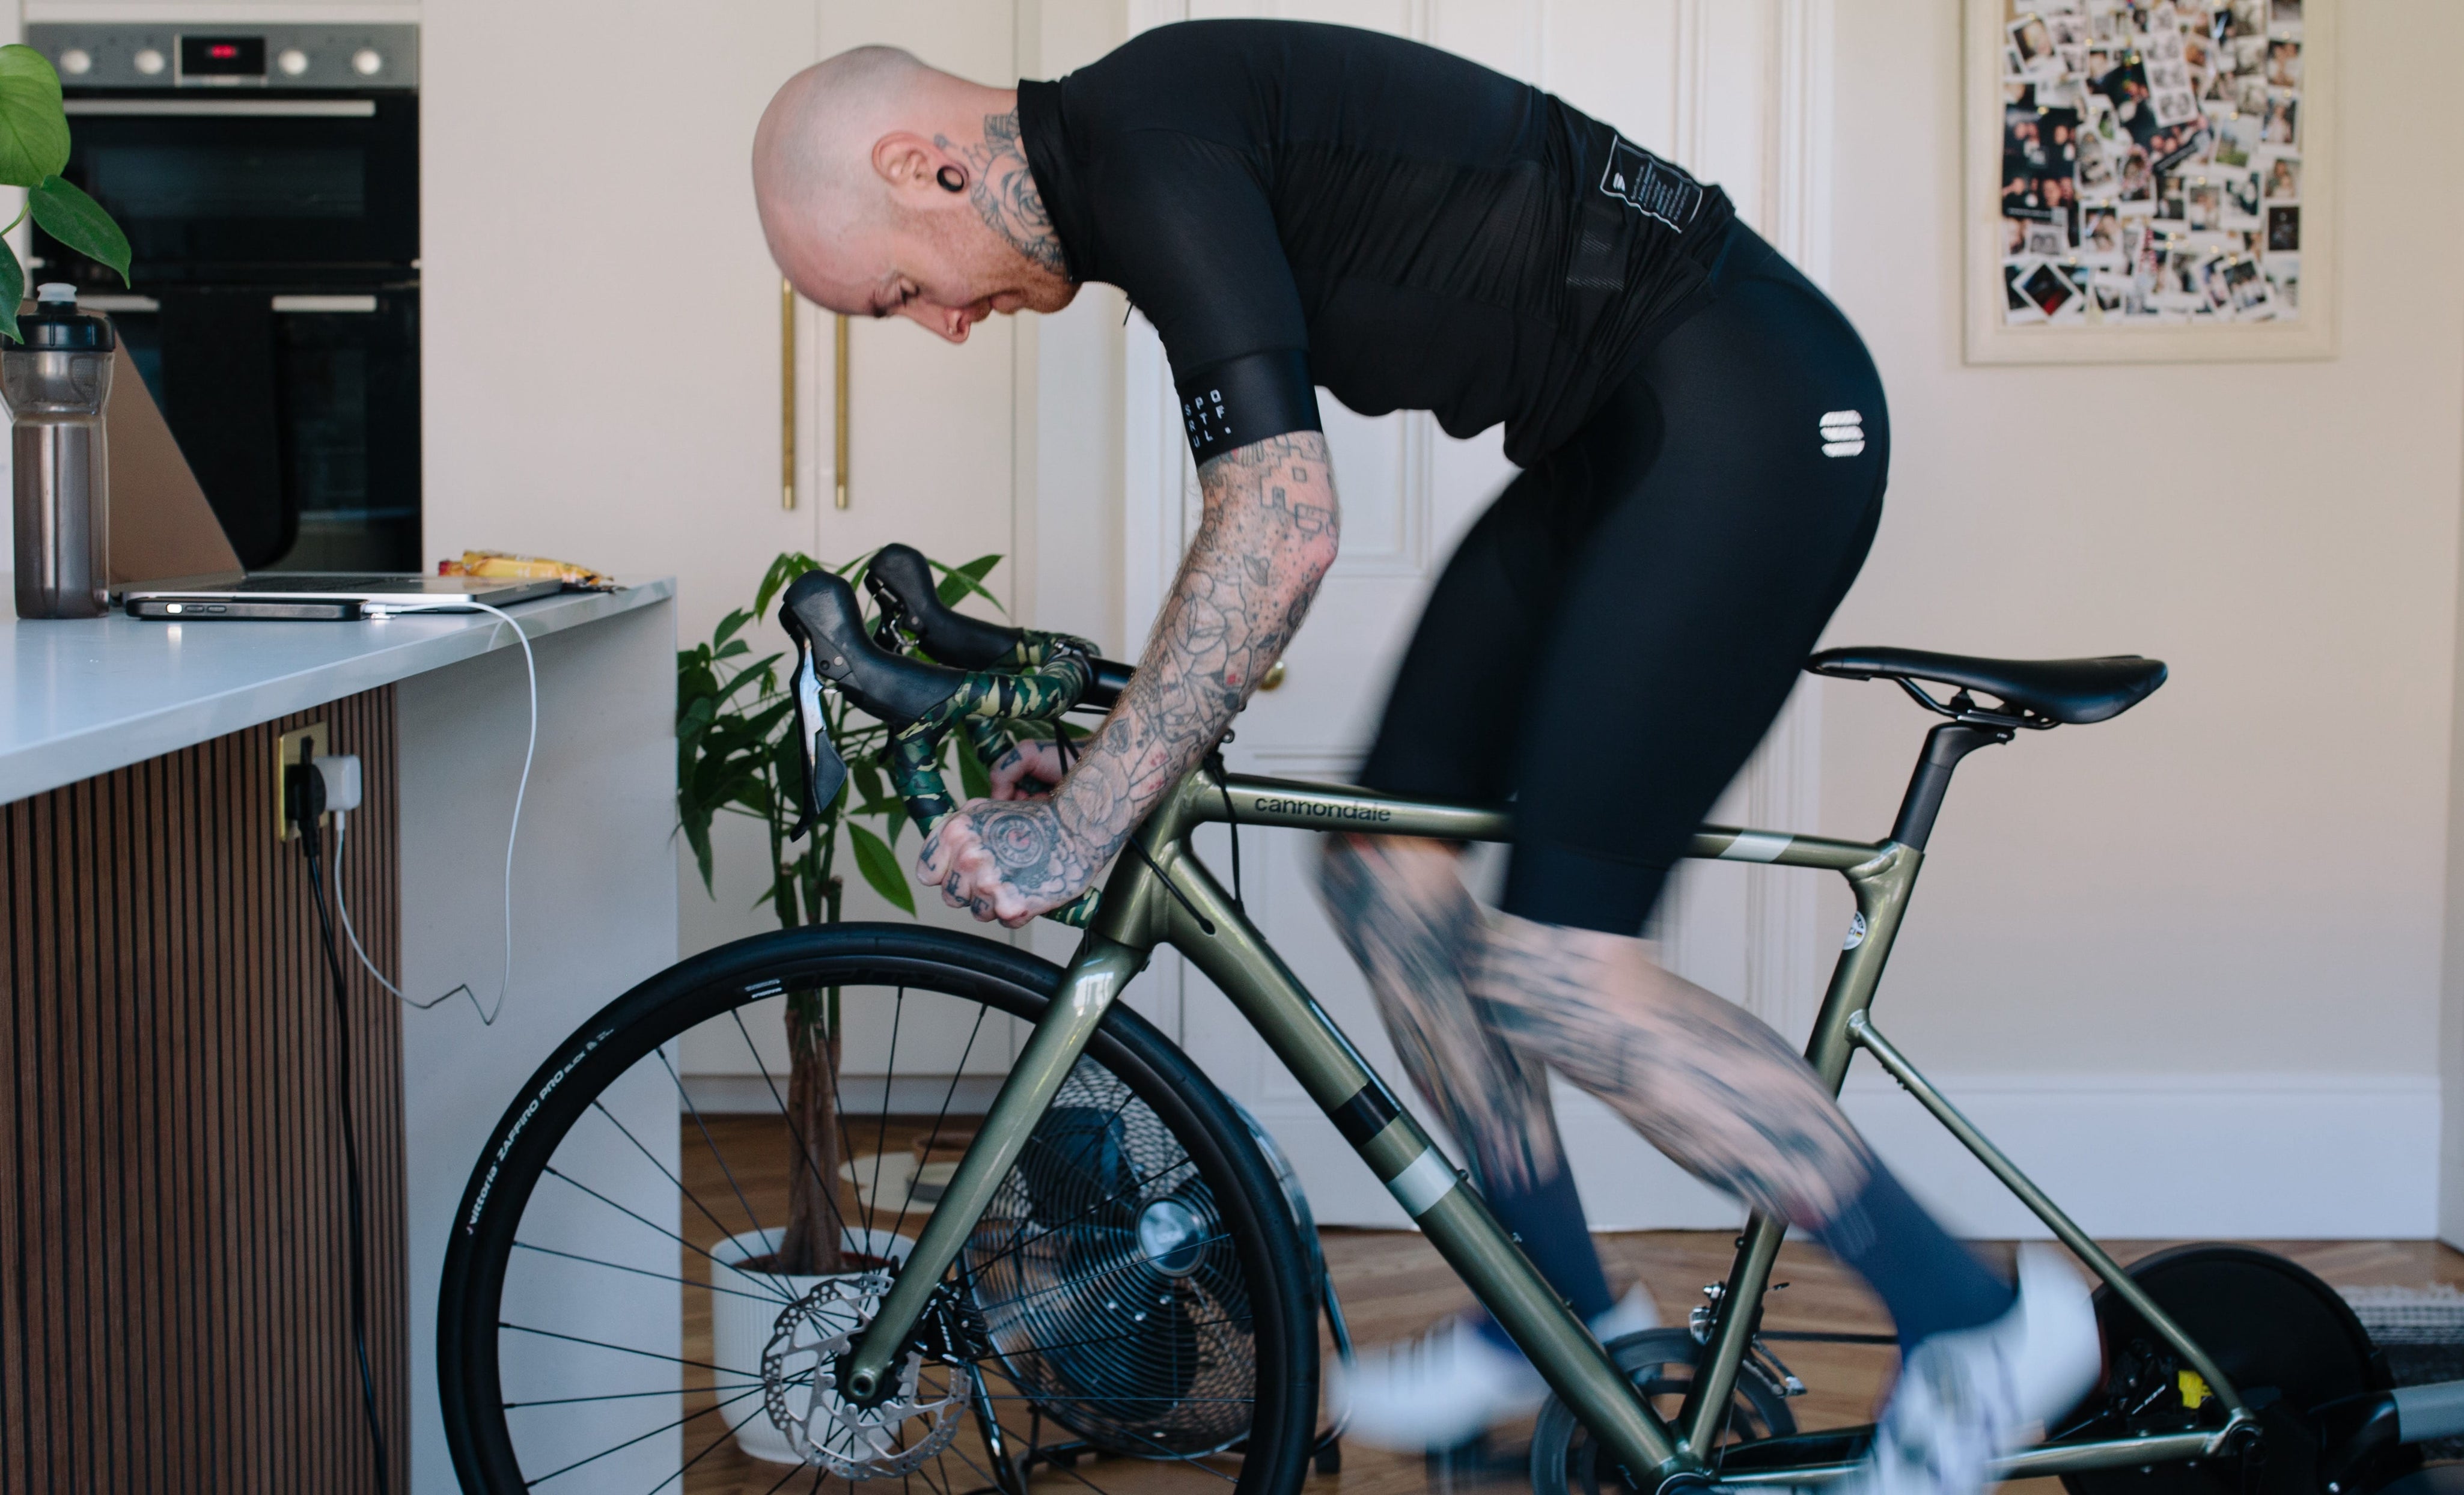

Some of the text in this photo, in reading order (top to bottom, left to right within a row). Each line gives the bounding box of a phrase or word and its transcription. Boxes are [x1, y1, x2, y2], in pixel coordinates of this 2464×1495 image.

[1255, 798, 1391, 821] cannondale
[469, 1165, 498, 1225] vittoria
[539, 1070, 564, 1100] PRO
